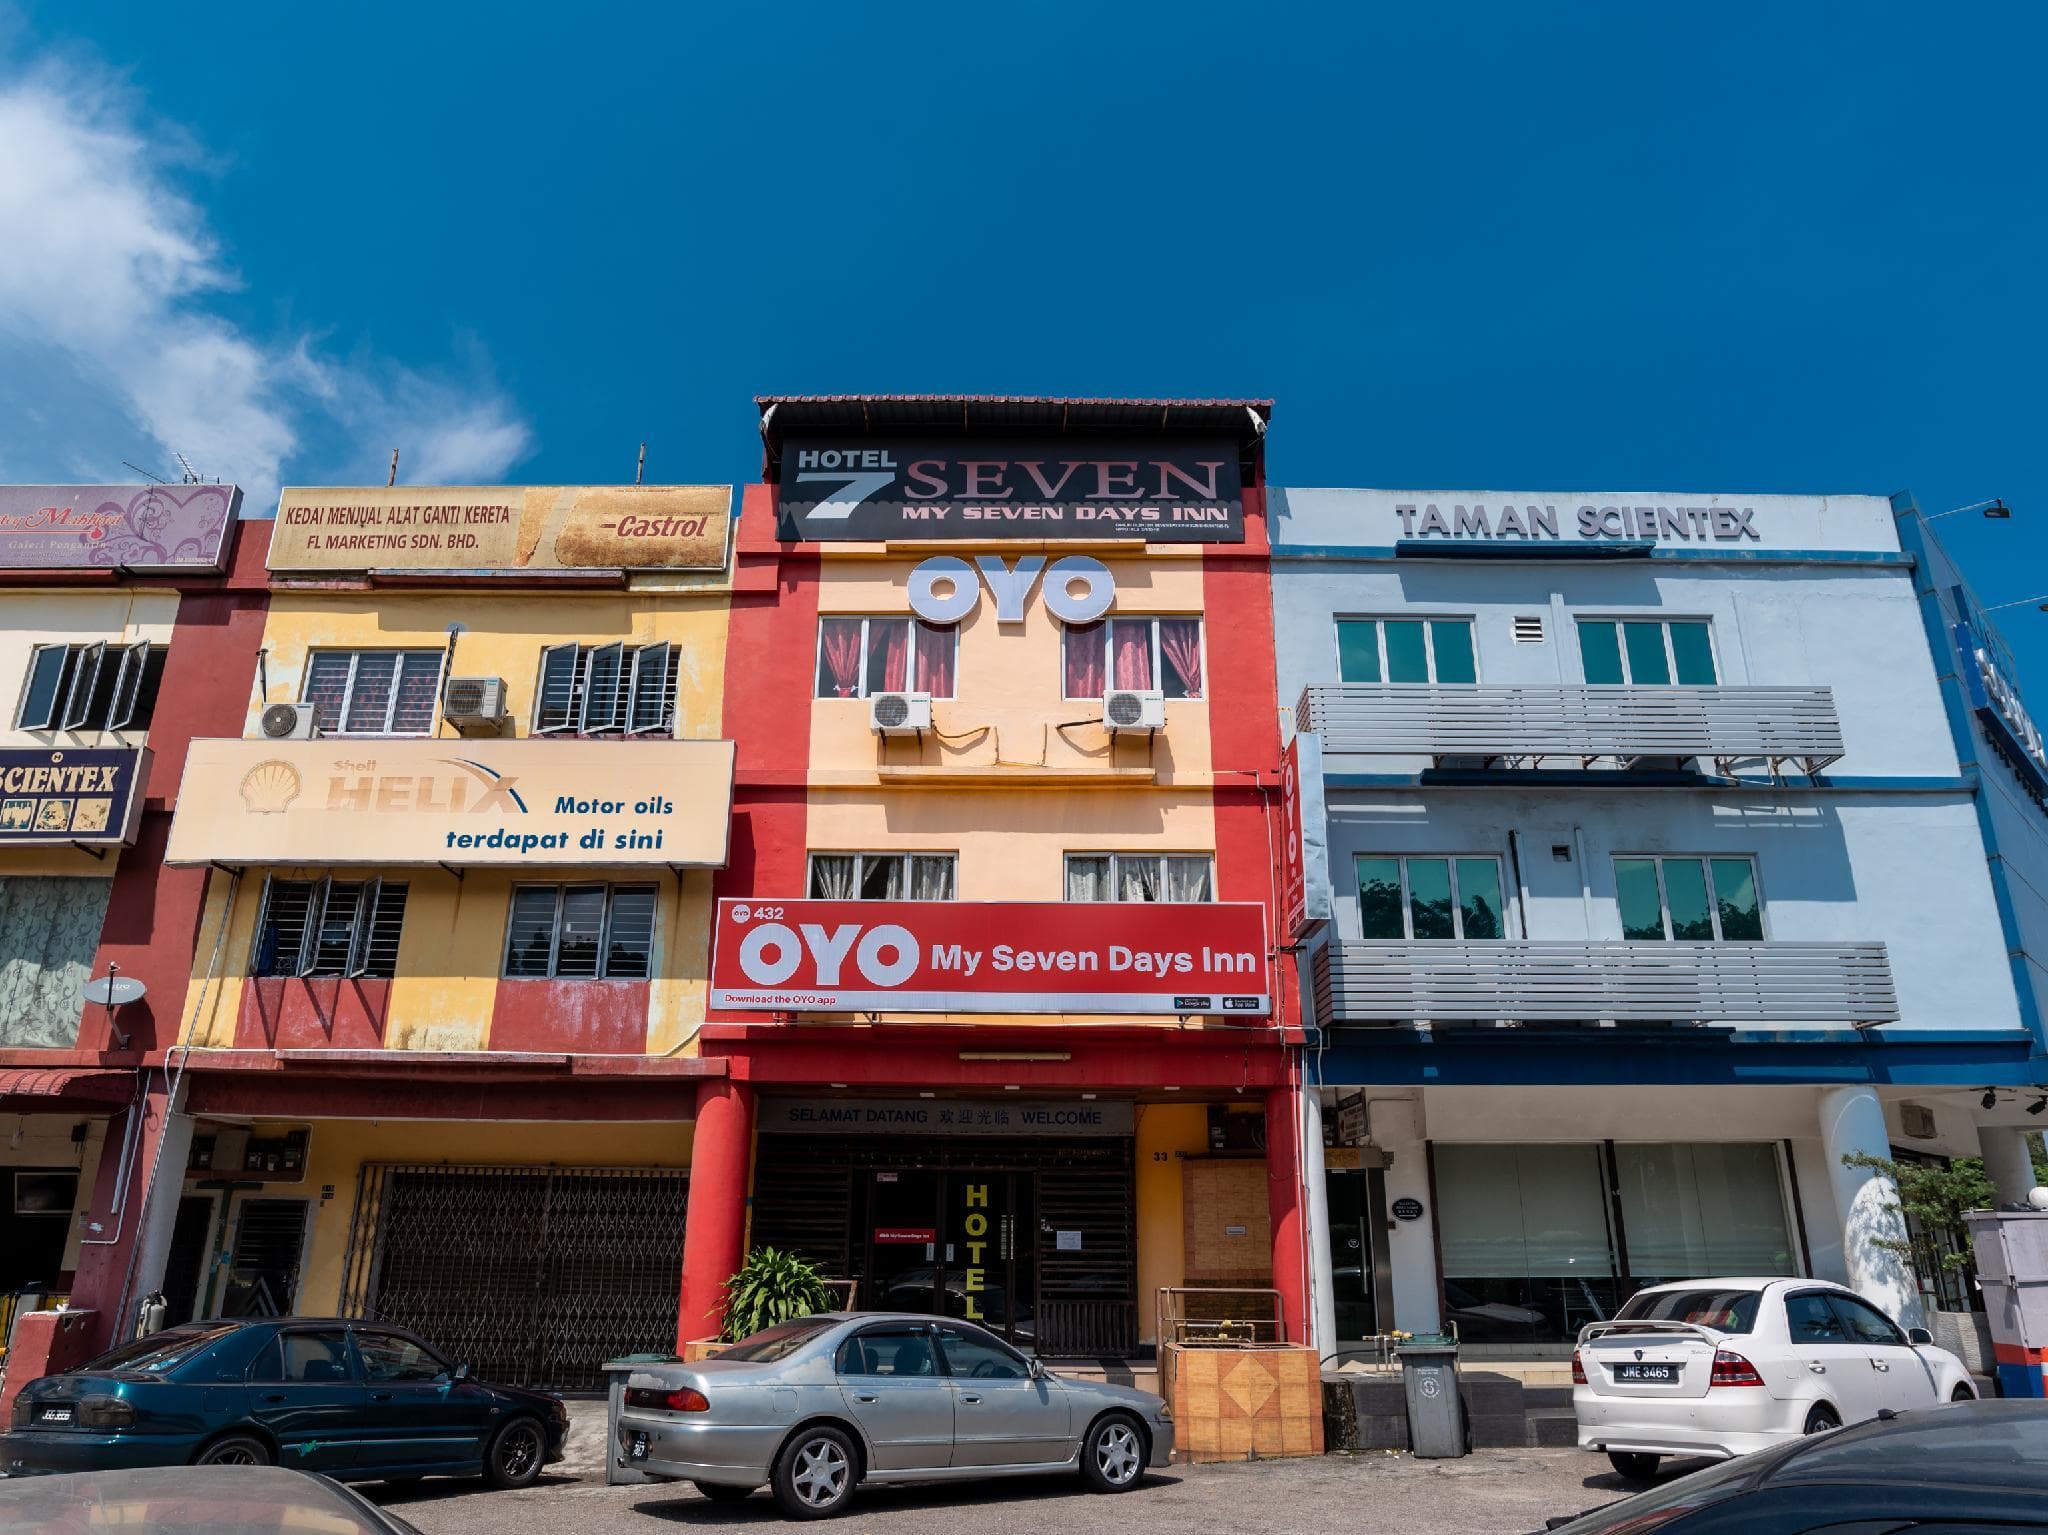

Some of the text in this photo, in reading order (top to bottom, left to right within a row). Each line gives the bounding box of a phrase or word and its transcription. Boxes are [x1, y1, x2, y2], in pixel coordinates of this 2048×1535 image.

[799, 450, 897, 468] HOTEL
[904, 460, 1225, 499] SEVEN
[796, 472, 896, 519] 7
[286, 505, 510, 525] KEDAI MENJUAL ALAT GANTI KERETA
[903, 506, 1228, 521] MY SEVEN DAYS INN
[1396, 504, 1760, 541] TAMAN SCIENTEX
[307, 534, 479, 549] FL MARKETING SDN. BHD.
[907, 555, 1116, 624] OYO
[333, 760, 377, 773] Shell
[324, 776, 520, 814] HELIX
[554, 796, 674, 815] Motor oils
[446, 828, 664, 854] terdapat di sini
[753, 906, 785, 920] 432
[739, 922, 1256, 987] OYO My Seven Days Inn
[724, 994, 836, 1006] Download the OYO app
[788, 1108, 928, 1124] SELAMAT DATANG
[940, 1109, 1010, 1125] 欢迎光临
[1021, 1111, 1102, 1125] WELCOME
[965, 1185, 988, 1320] HOTEL
